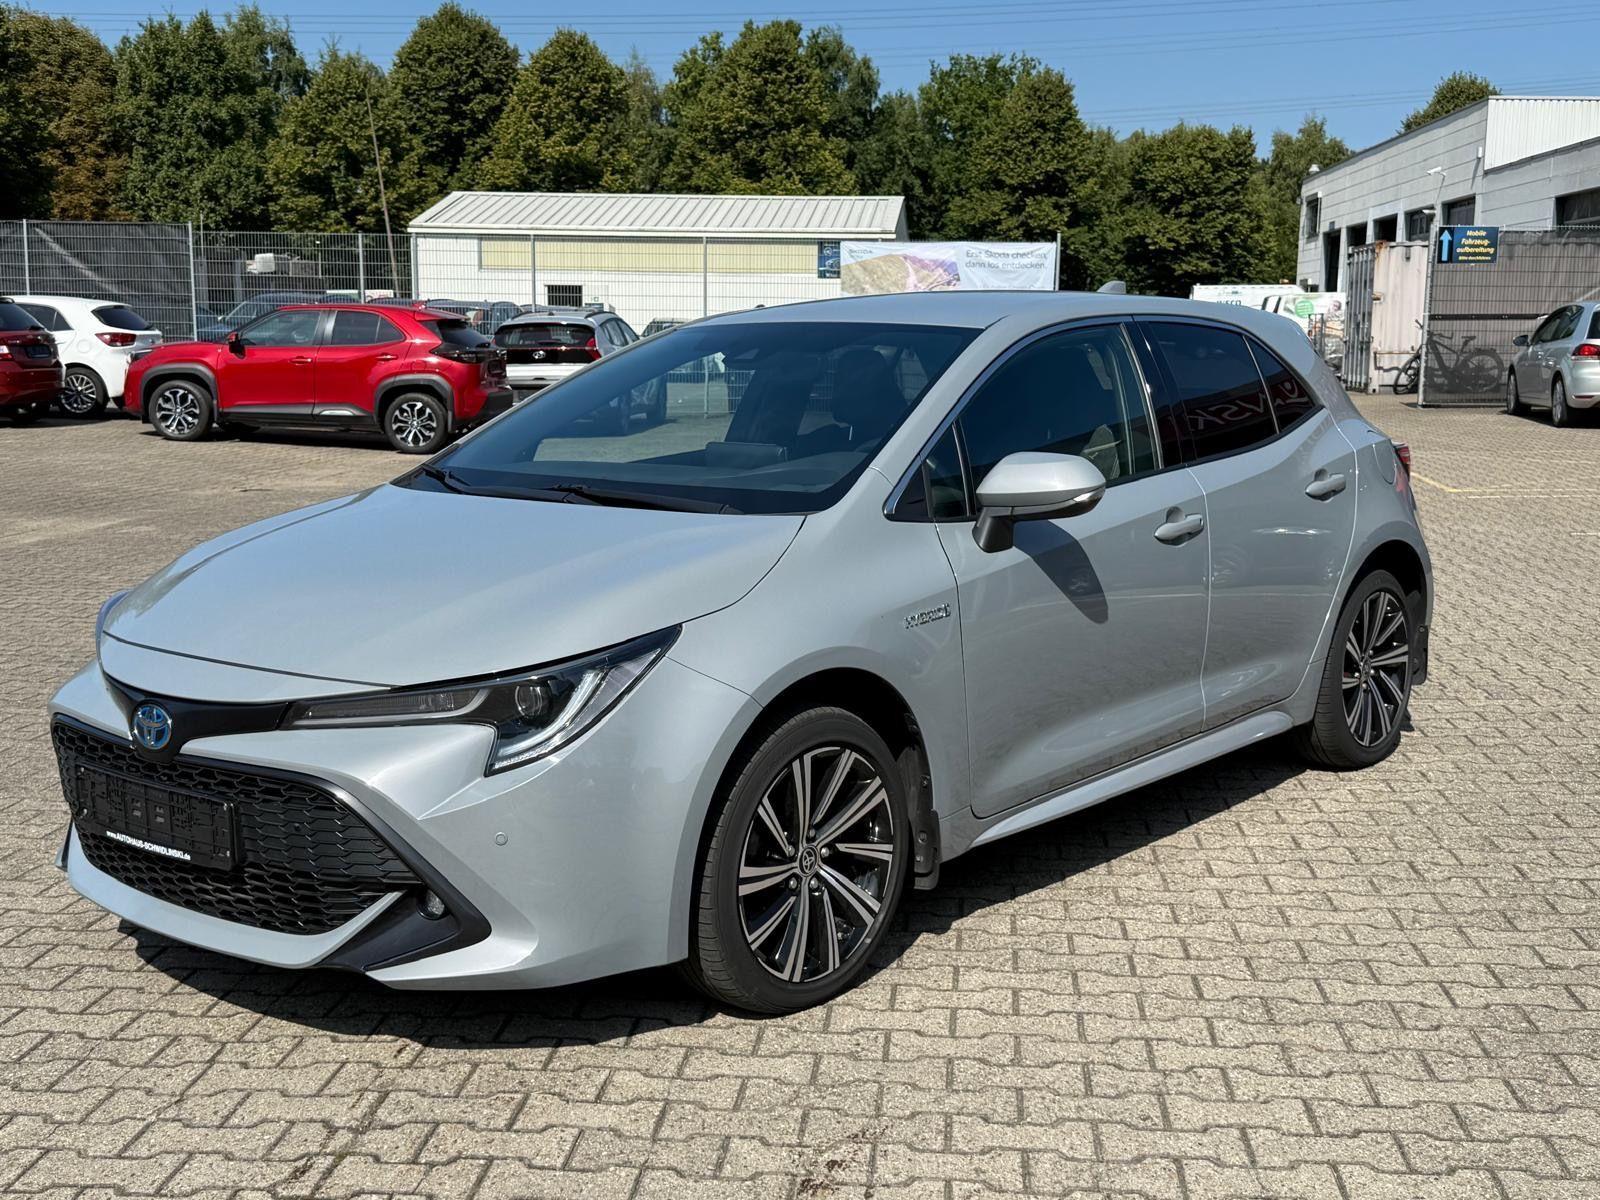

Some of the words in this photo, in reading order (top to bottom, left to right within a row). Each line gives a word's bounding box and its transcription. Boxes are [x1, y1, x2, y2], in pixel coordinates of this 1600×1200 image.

[1461, 238, 1491, 246] Fahrzeug-
[965, 261, 986, 269] dann
[904, 603, 951, 629] HYBRID
